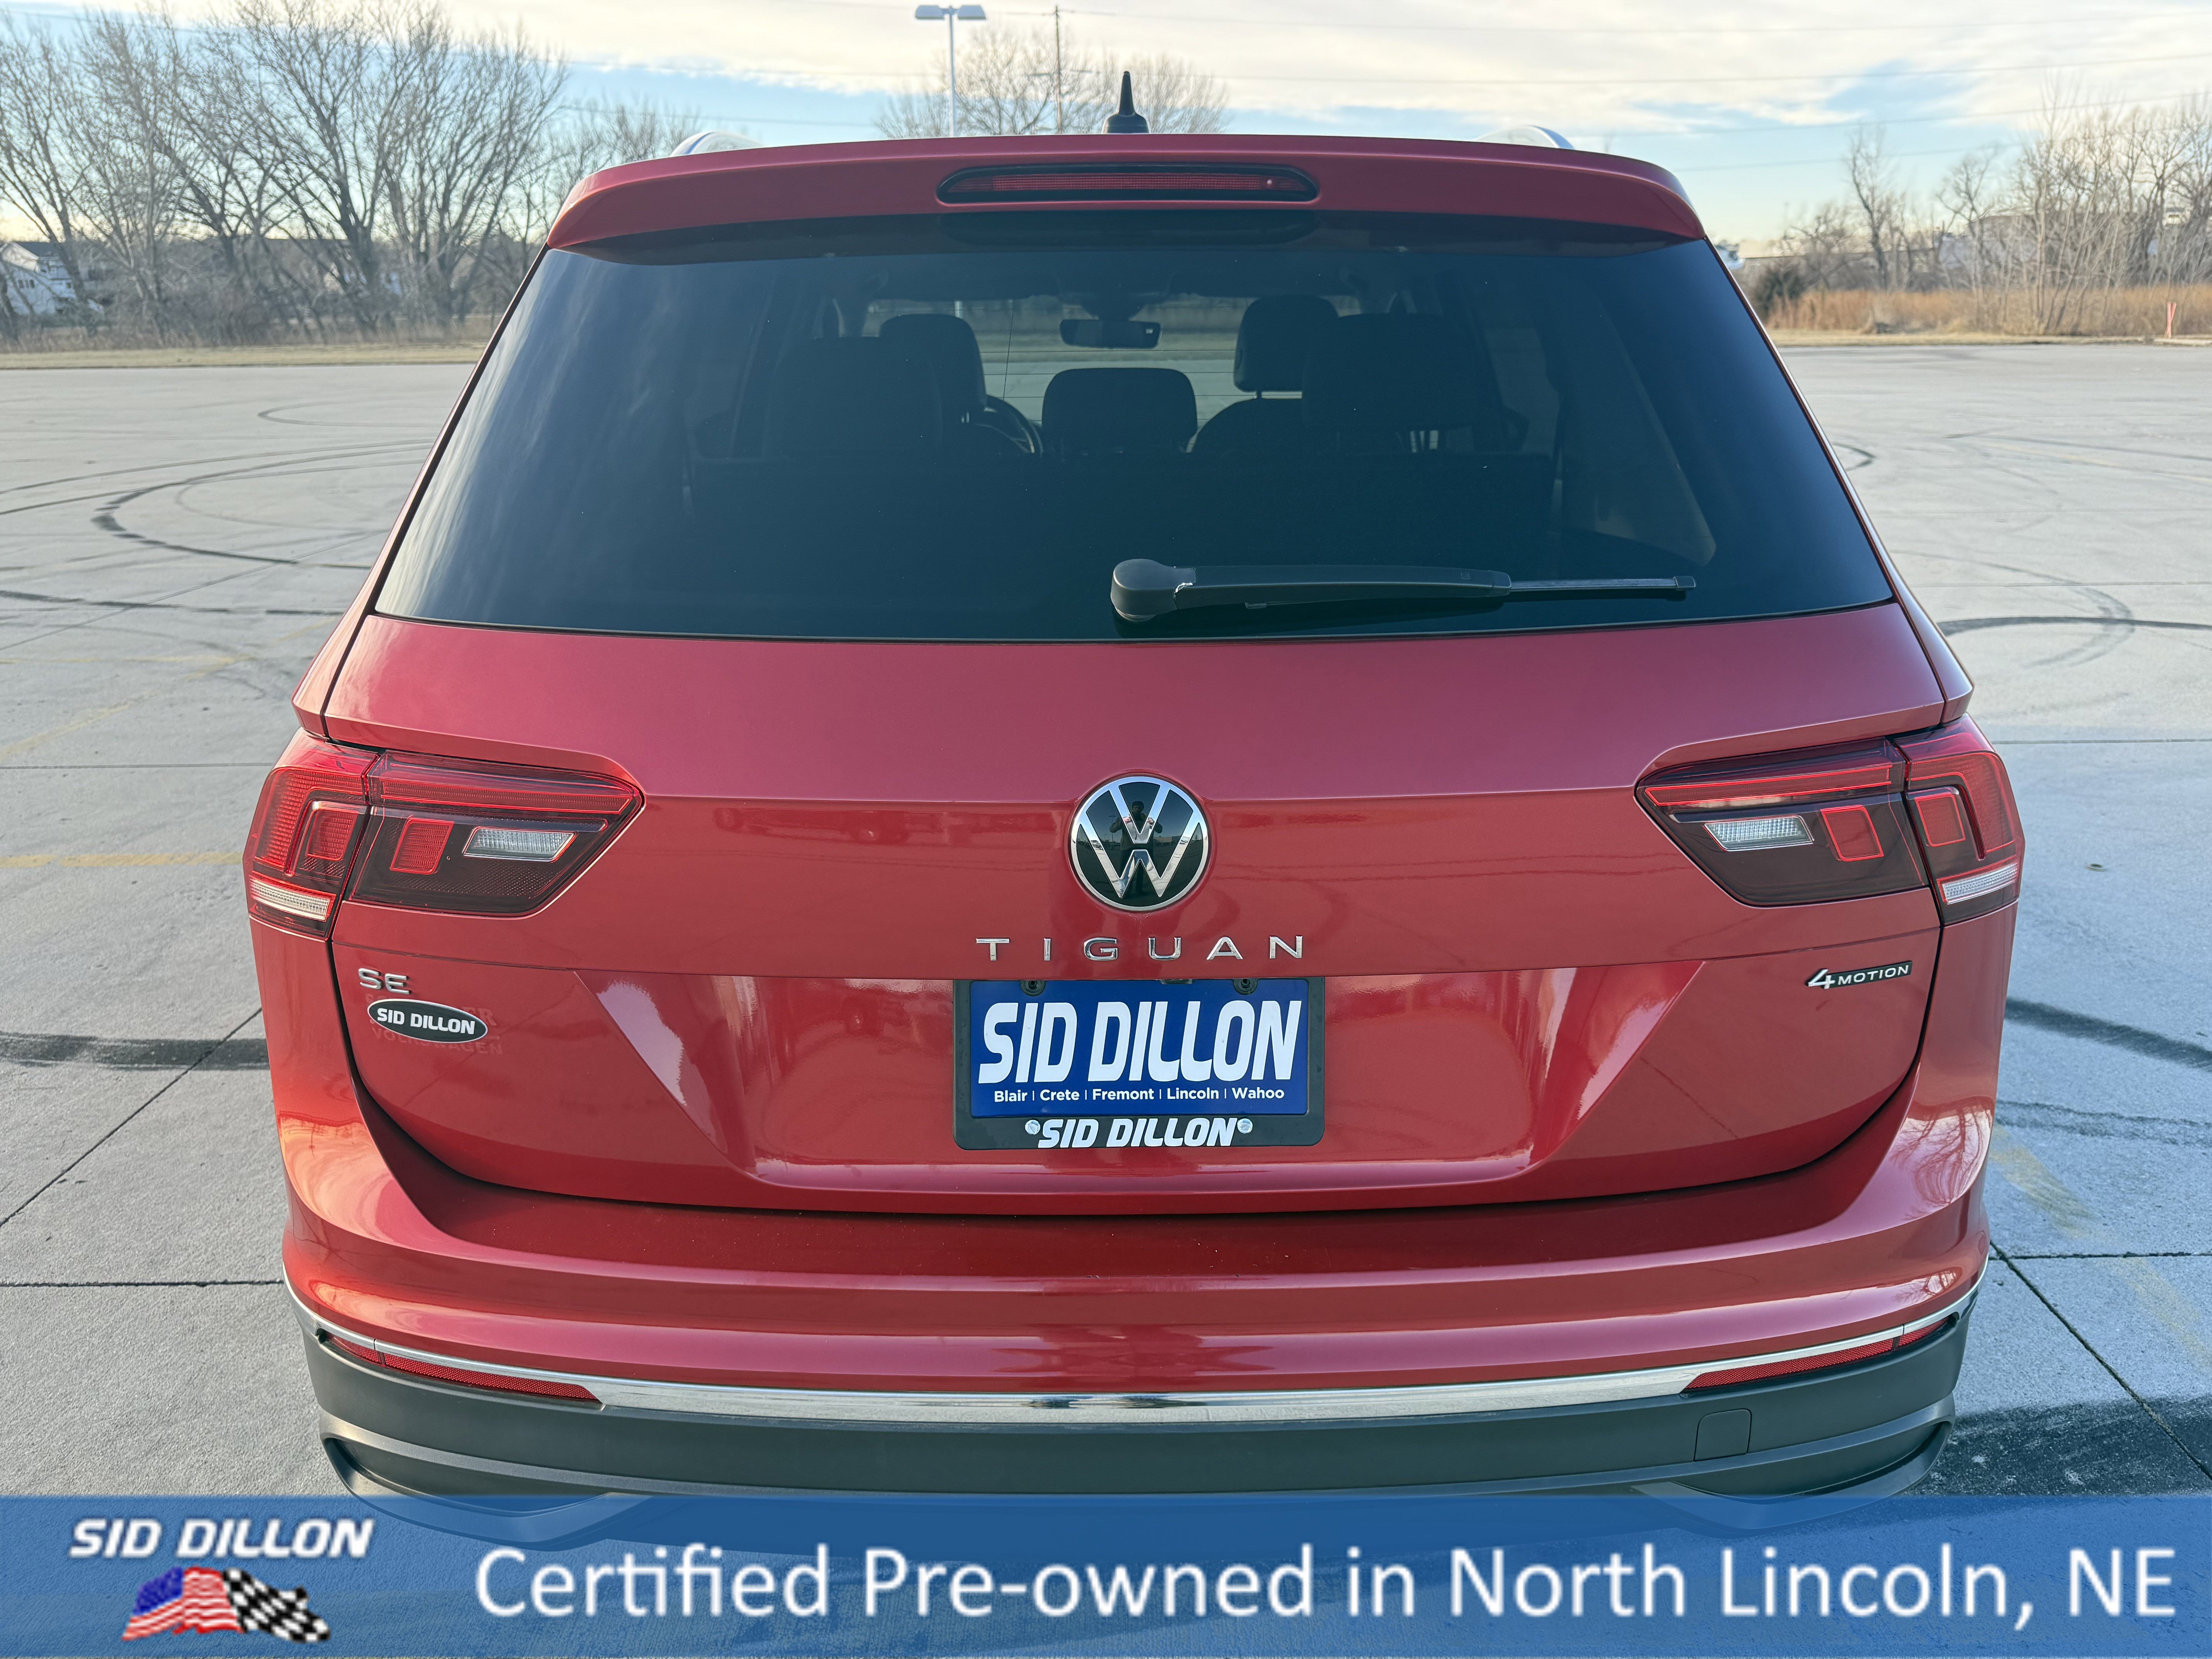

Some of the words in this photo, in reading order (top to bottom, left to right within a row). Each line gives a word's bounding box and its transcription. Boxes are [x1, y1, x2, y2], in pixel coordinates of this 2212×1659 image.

[975, 936, 1303, 961] TIGUAN
[358, 968, 410, 994] SE
[377, 1008, 405, 1025] SID
[410, 1013, 476, 1035] DILLON
[978, 1002, 1077, 1084] SID
[1087, 1000, 1302, 1082] DILLON
[994, 1089, 1028, 1103] Blair
[1039, 1089, 1080, 1101] Crete
[1092, 1088, 1155, 1101] Fremont
[1167, 1087, 1219, 1100] Lincoln
[1231, 1087, 1285, 1099] Wahoo
[1038, 1119, 1099, 1148] SID
[1106, 1118, 1238, 1147] DILLON
